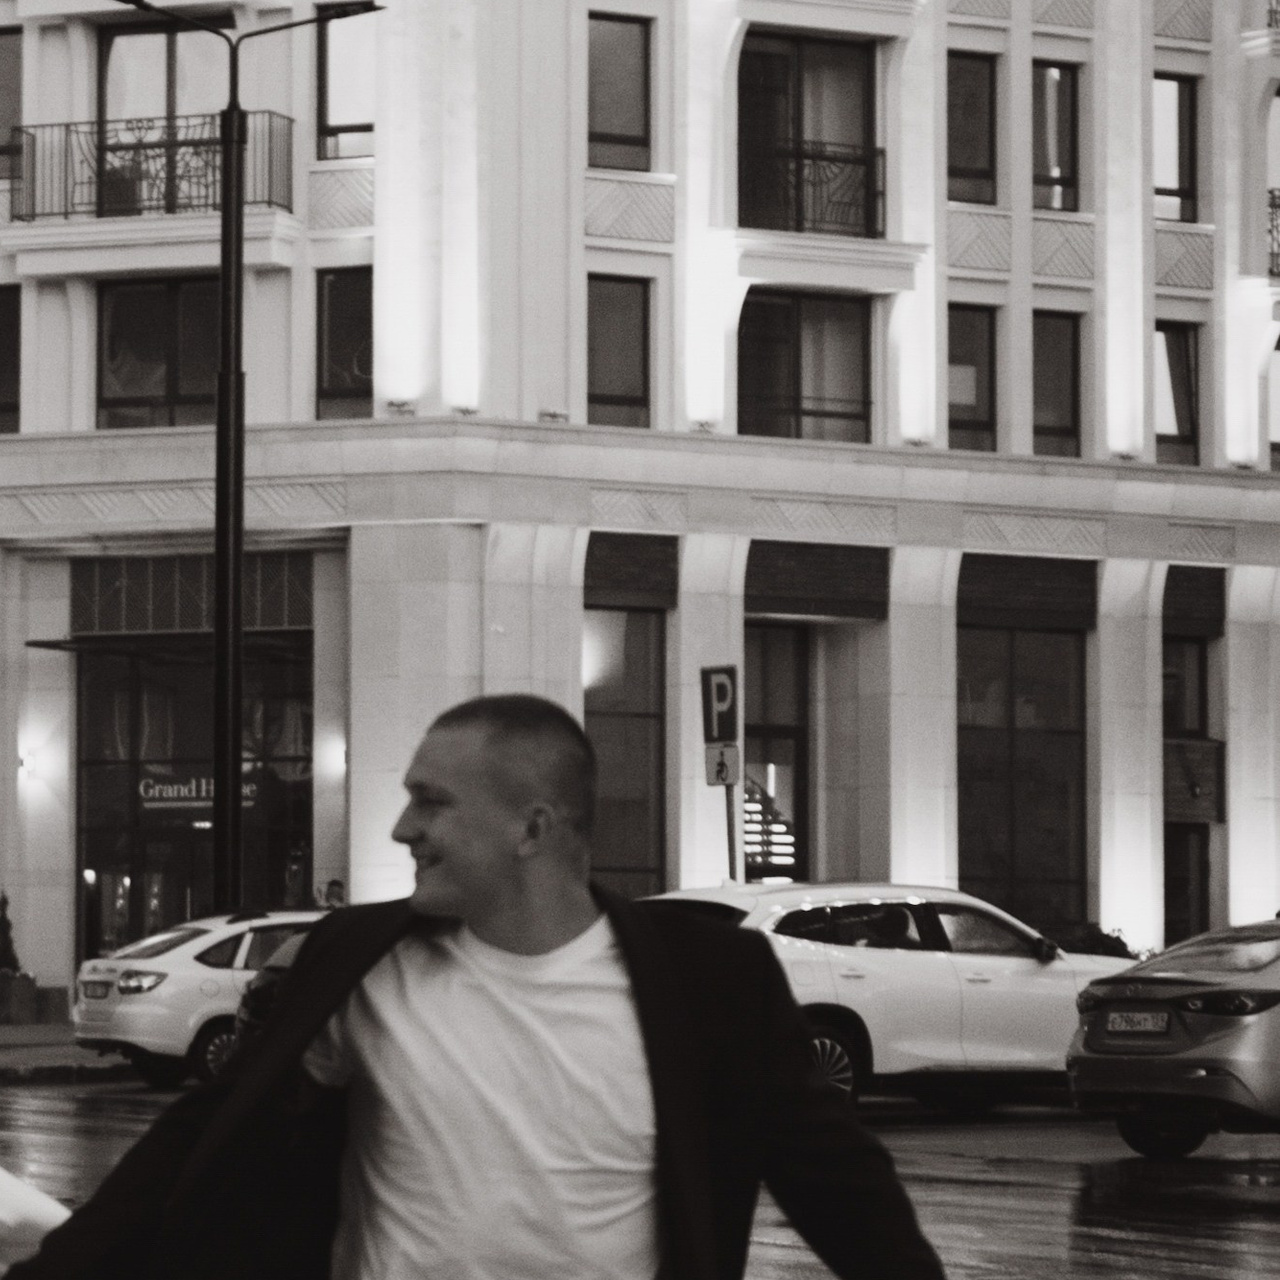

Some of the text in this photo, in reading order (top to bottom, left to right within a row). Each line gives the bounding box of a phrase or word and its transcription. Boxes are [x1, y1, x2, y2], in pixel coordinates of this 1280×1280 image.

[711, 673, 733, 738] P
[140, 778, 257, 798] Grand Hse
